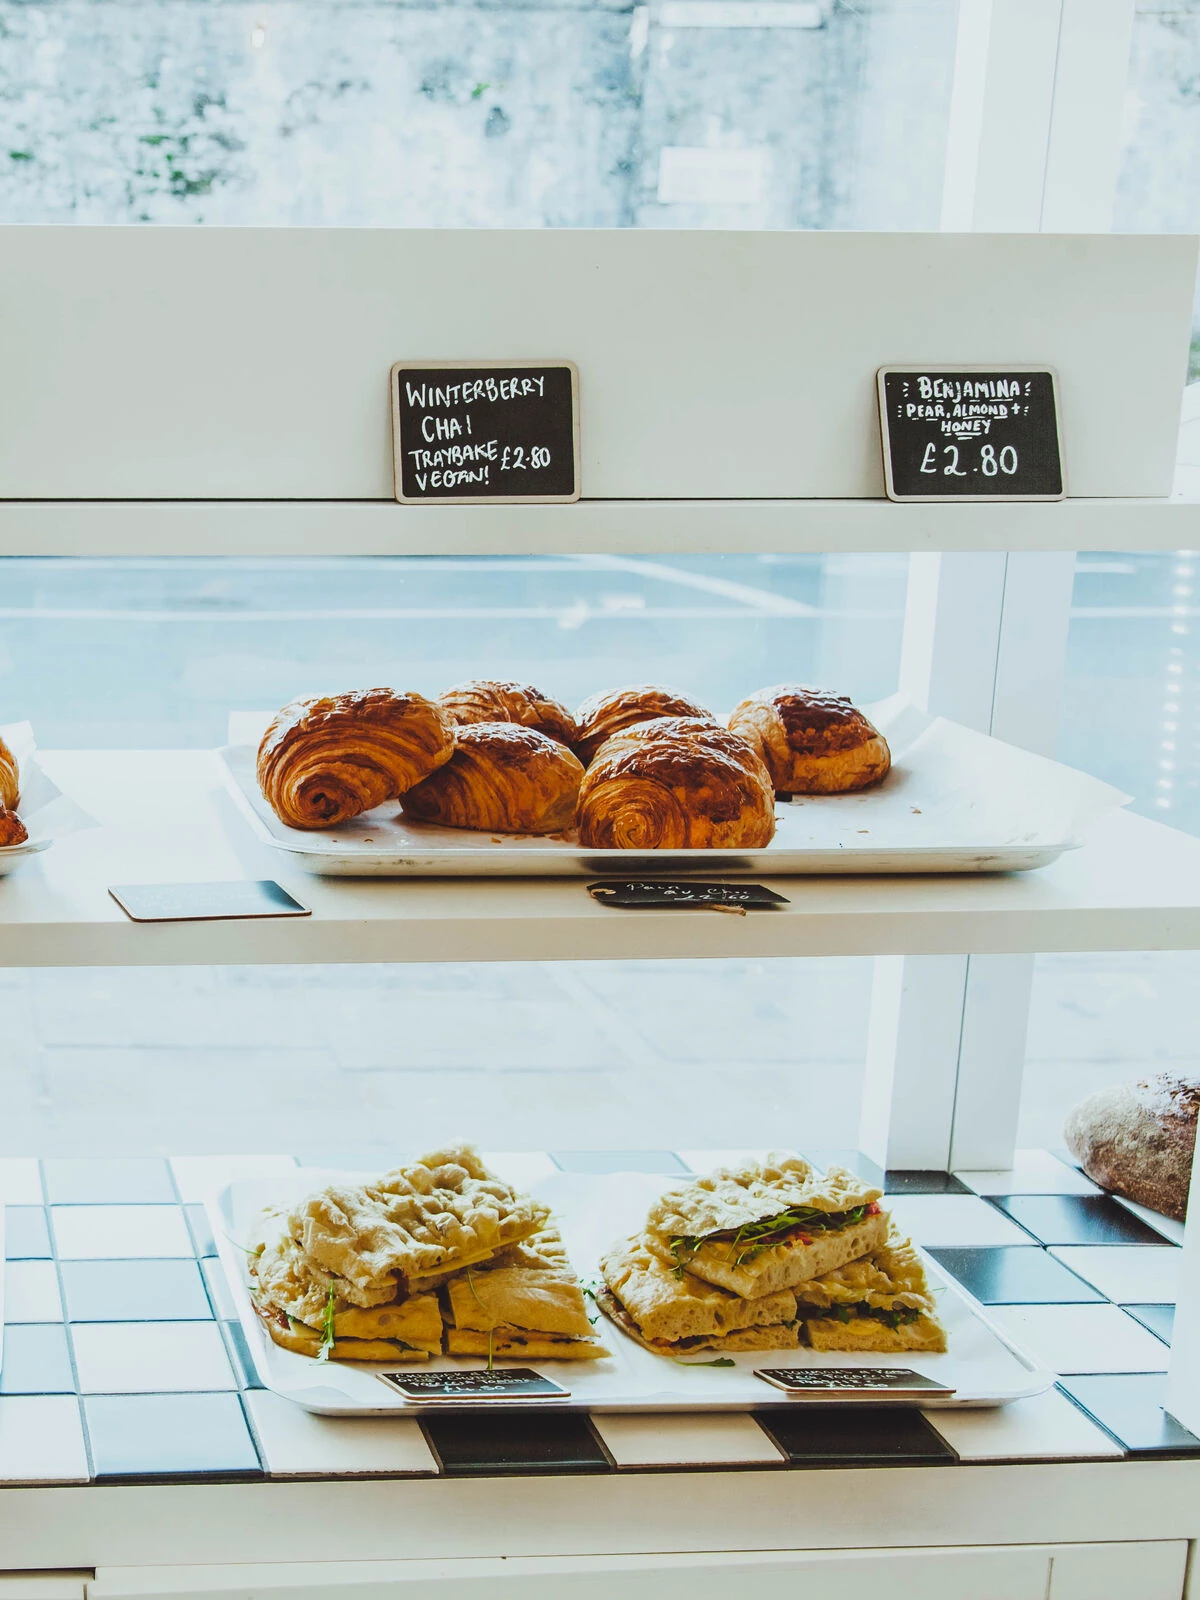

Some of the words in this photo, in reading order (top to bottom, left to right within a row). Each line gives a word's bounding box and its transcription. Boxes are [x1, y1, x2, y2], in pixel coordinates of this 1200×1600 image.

[405, 376, 545, 408] WINTERBERRY
[917, 376, 1021, 403] BENJAMINA
[952, 404, 1008, 418] ALMOND
[421, 414, 473, 443] CHAI
[941, 419, 992, 434] HONEY
[408, 440, 499, 470] TRAYBAKE
[500, 446, 551, 471] £2.80
[919, 442, 1018, 477] £2.80
[414, 465, 490, 491] VEGAN!
